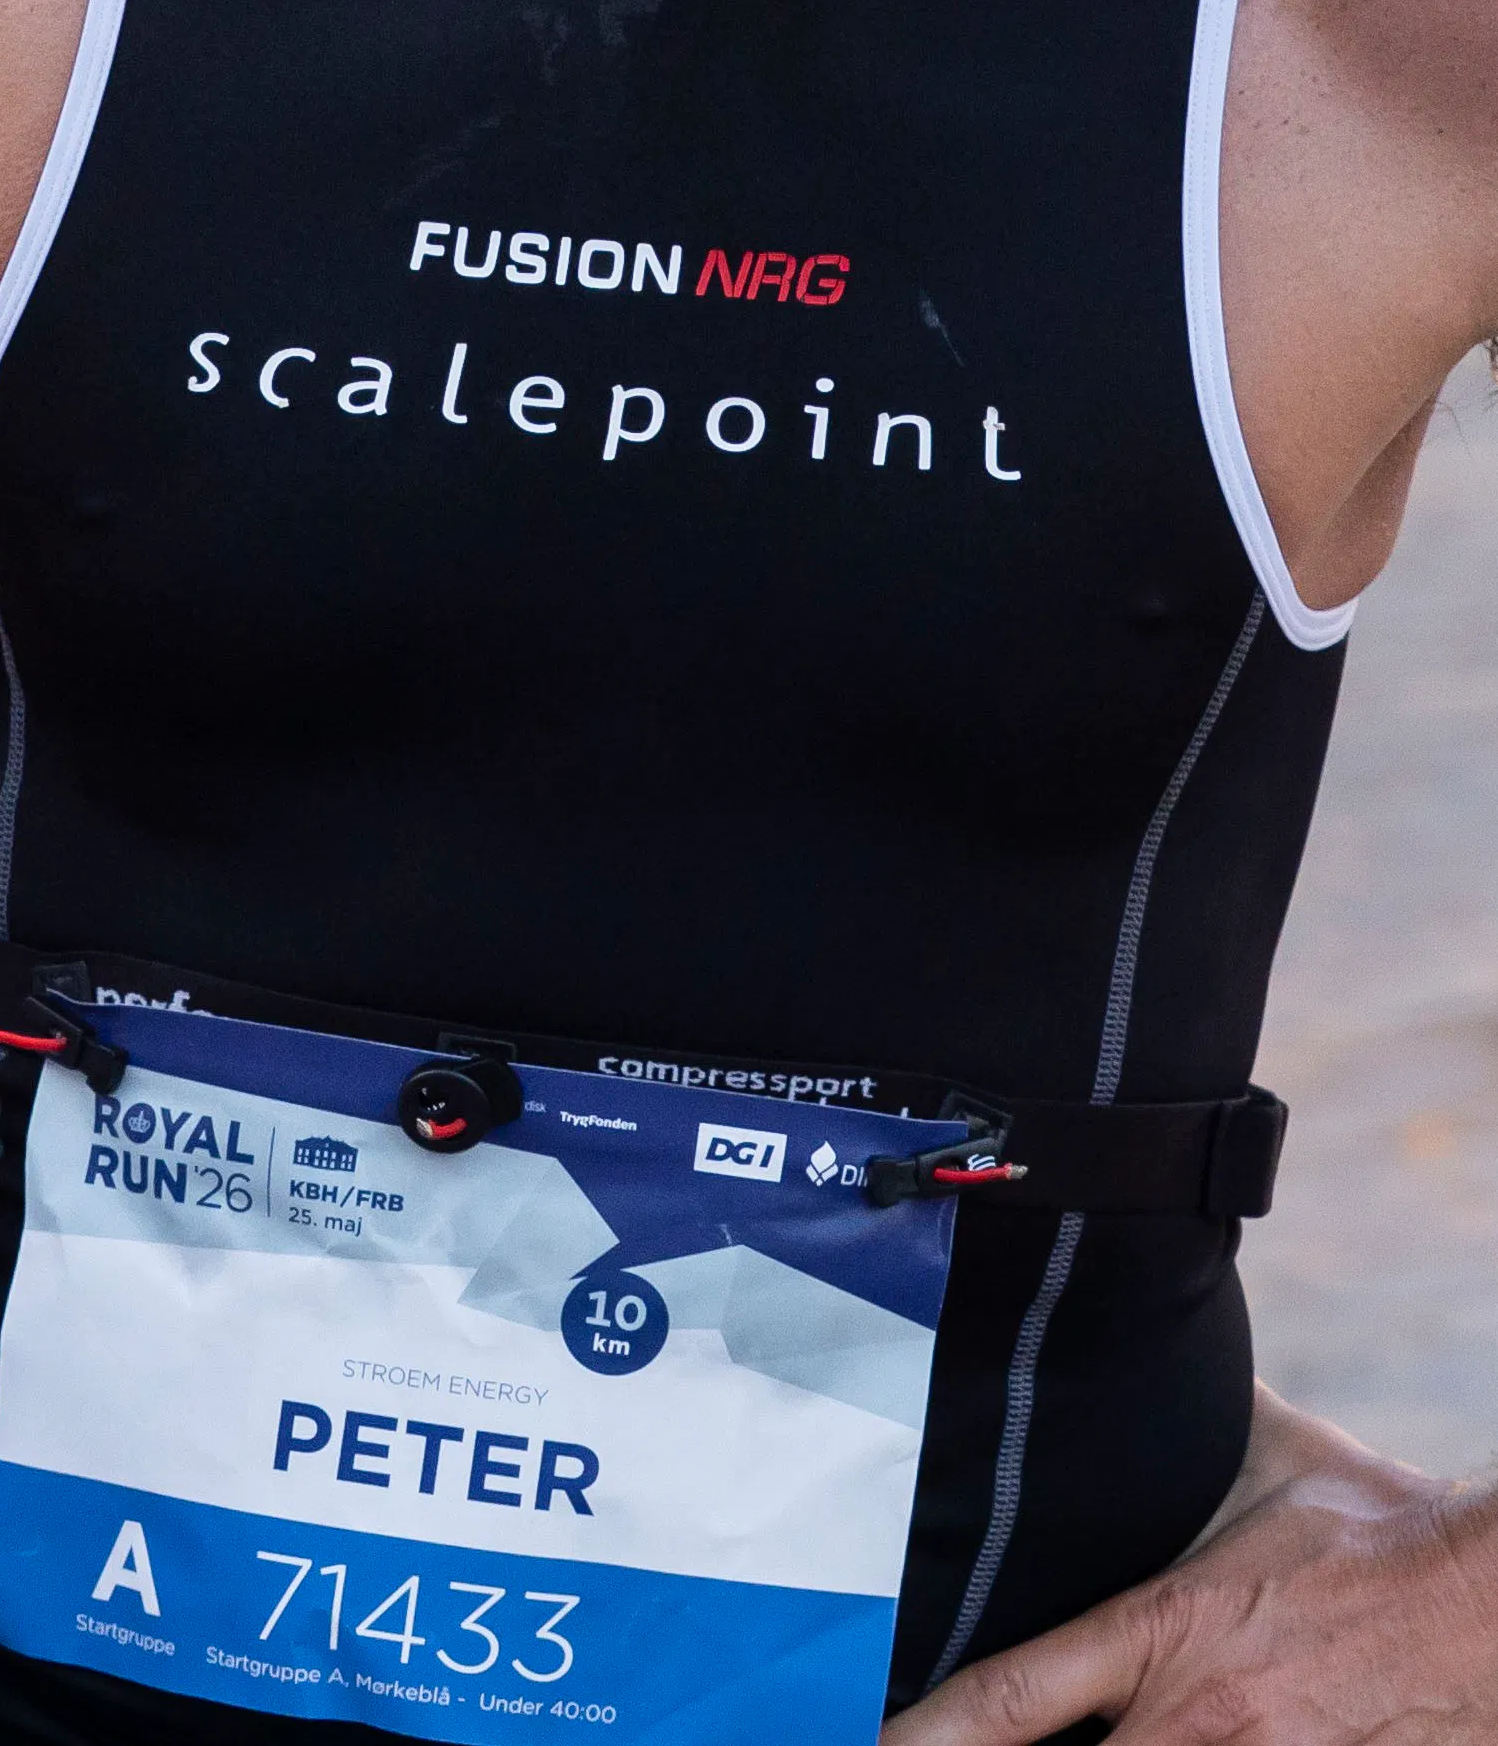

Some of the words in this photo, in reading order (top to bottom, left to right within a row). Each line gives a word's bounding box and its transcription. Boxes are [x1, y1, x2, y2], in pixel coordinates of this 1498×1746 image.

[409, 220, 682, 295] FUSION
[695, 249, 851, 306] NRG
[188, 332, 1022, 481] scalepoint
[598, 1055, 878, 1102] compressport
[93, 1093, 255, 1166] ROYAL
[559, 1111, 637, 1132] TrygFonden
[705, 1137, 777, 1168] DGI
[288, 1207, 318, 1227] 25.
[324, 1217, 363, 1237] maj
[584, 1290, 648, 1332] 10
[592, 1332, 631, 1356] km
[342, 1359, 441, 1392] STROEM
[448, 1375, 550, 1406] ENERGY
[272, 1398, 601, 1518] PETER
[90, 1519, 162, 1618] A
[75, 1613, 176, 1656] Startgruppe
[255, 1550, 581, 1684] 71433
[205, 1645, 322, 1685] Startgruppe
[356, 1673, 451, 1706] Mørkeblå
[479, 1692, 544, 1716] Under
[549, 1700, 617, 1725] 40:00
